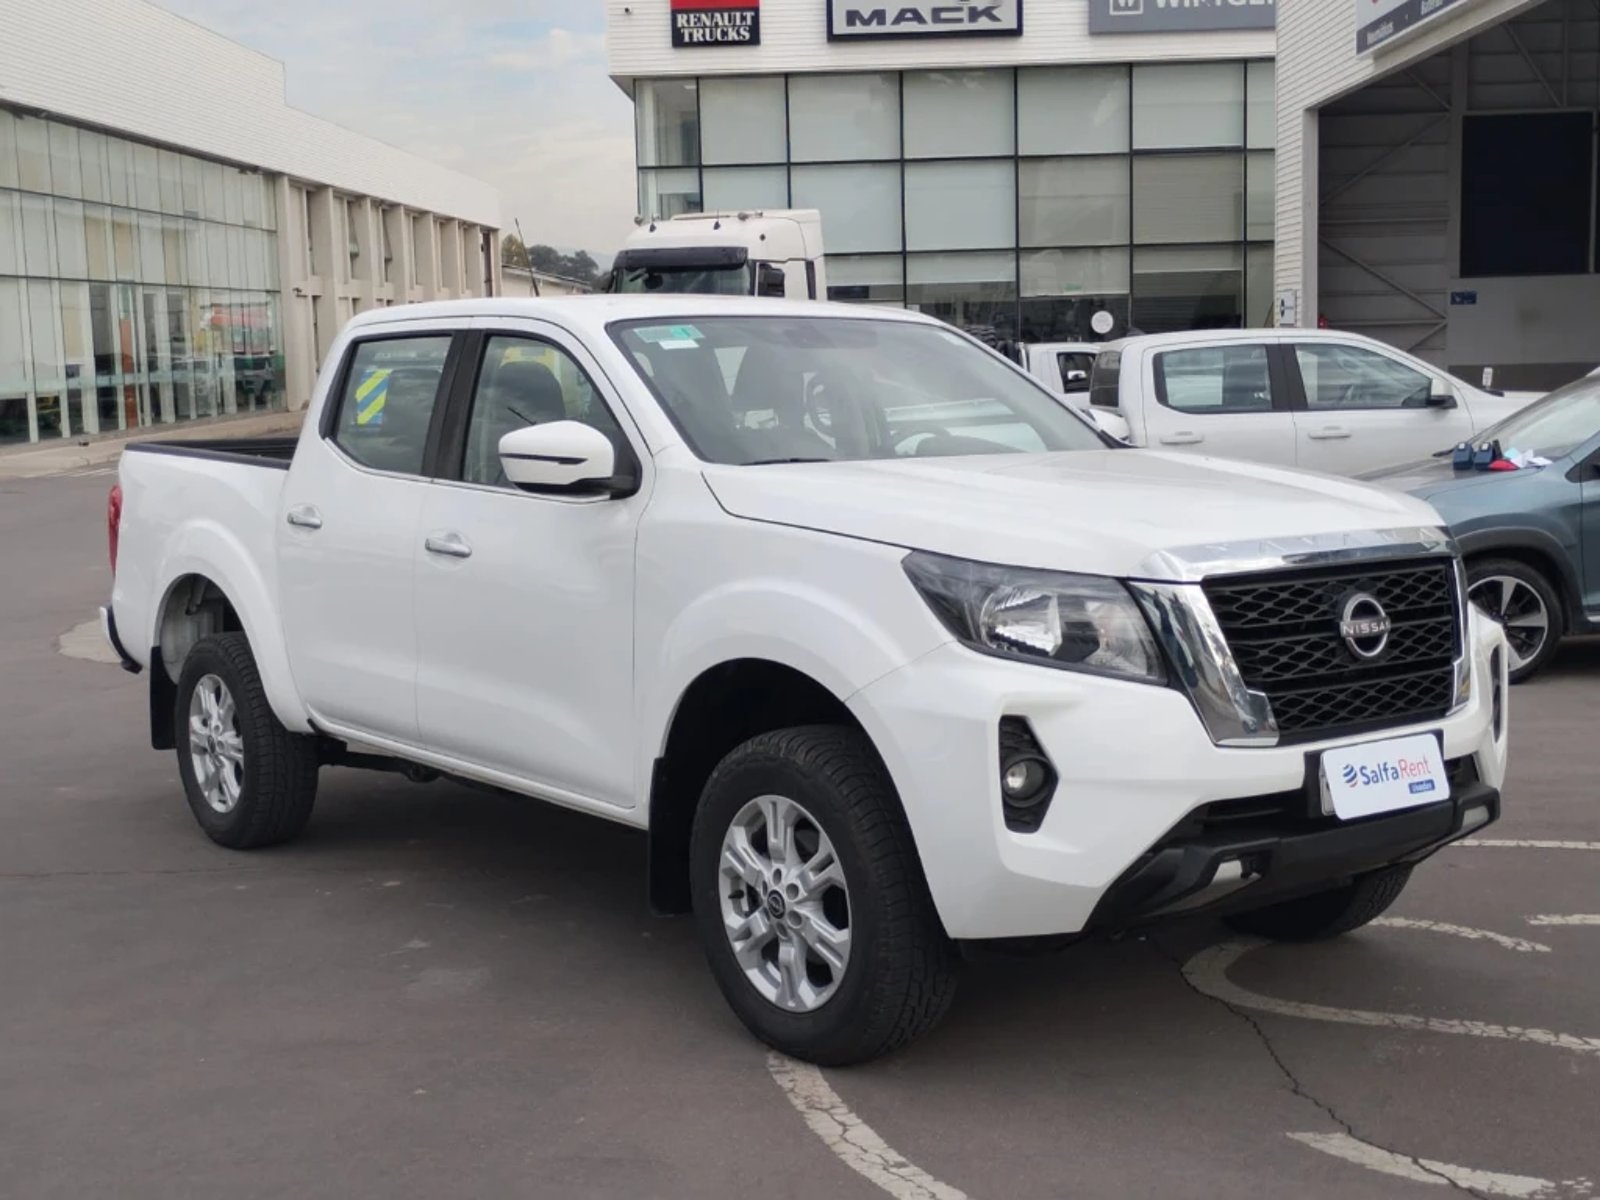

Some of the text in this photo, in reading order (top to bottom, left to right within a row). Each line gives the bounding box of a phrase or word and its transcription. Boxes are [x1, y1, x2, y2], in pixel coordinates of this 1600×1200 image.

[676, 11, 755, 28] RENAULT
[845, 5, 1003, 27] MACK
[680, 25, 751, 42] TRUCKS
[1359, 755, 1432, 786] SalfaRent
